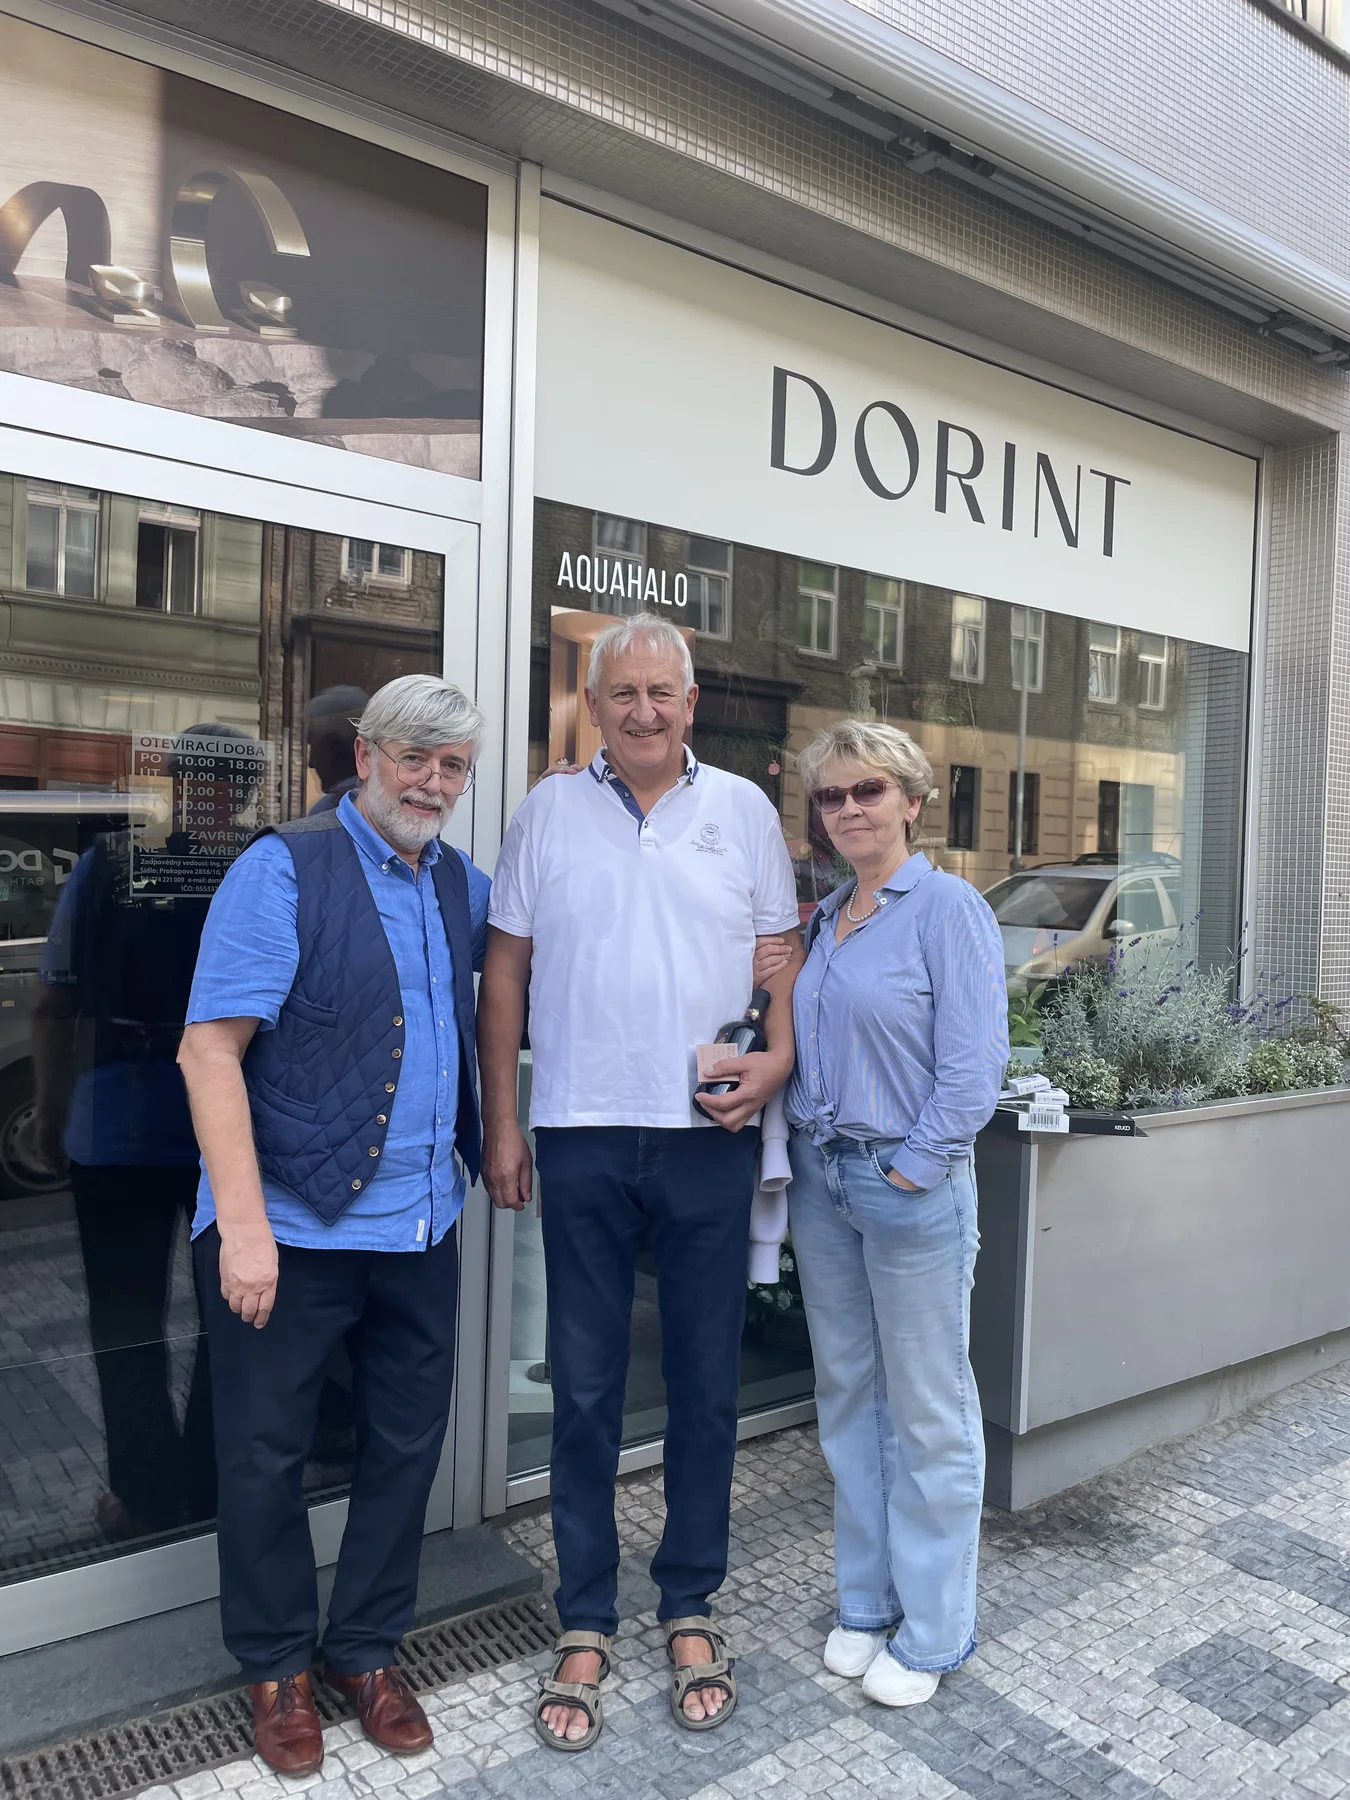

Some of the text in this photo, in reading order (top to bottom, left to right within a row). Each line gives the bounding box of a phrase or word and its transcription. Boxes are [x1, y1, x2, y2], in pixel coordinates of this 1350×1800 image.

[770, 365, 1131, 558] DORINT
[557, 551, 688, 607] AQUAHALO
[140, 736, 265, 757] OTEVÍRACÍ DOBA
[140, 752, 162, 764] PO
[177, 756, 215, 767] 10.00
[228, 760, 265, 771] 18.00
[177, 770, 215, 782] 10.00
[228, 774, 265, 785] 18.00
[176, 785, 215, 796] 10.00
[228, 788, 264, 799] 18.00
[176, 800, 215, 811] 10.00
[176, 815, 215, 826] 10.00
[188, 844, 243, 856] ZAVŘEN
[140, 858, 182, 867] Zodpovědný
[160, 867, 193, 876] Prokopova
[181, 884, 194, 892] IČO:
